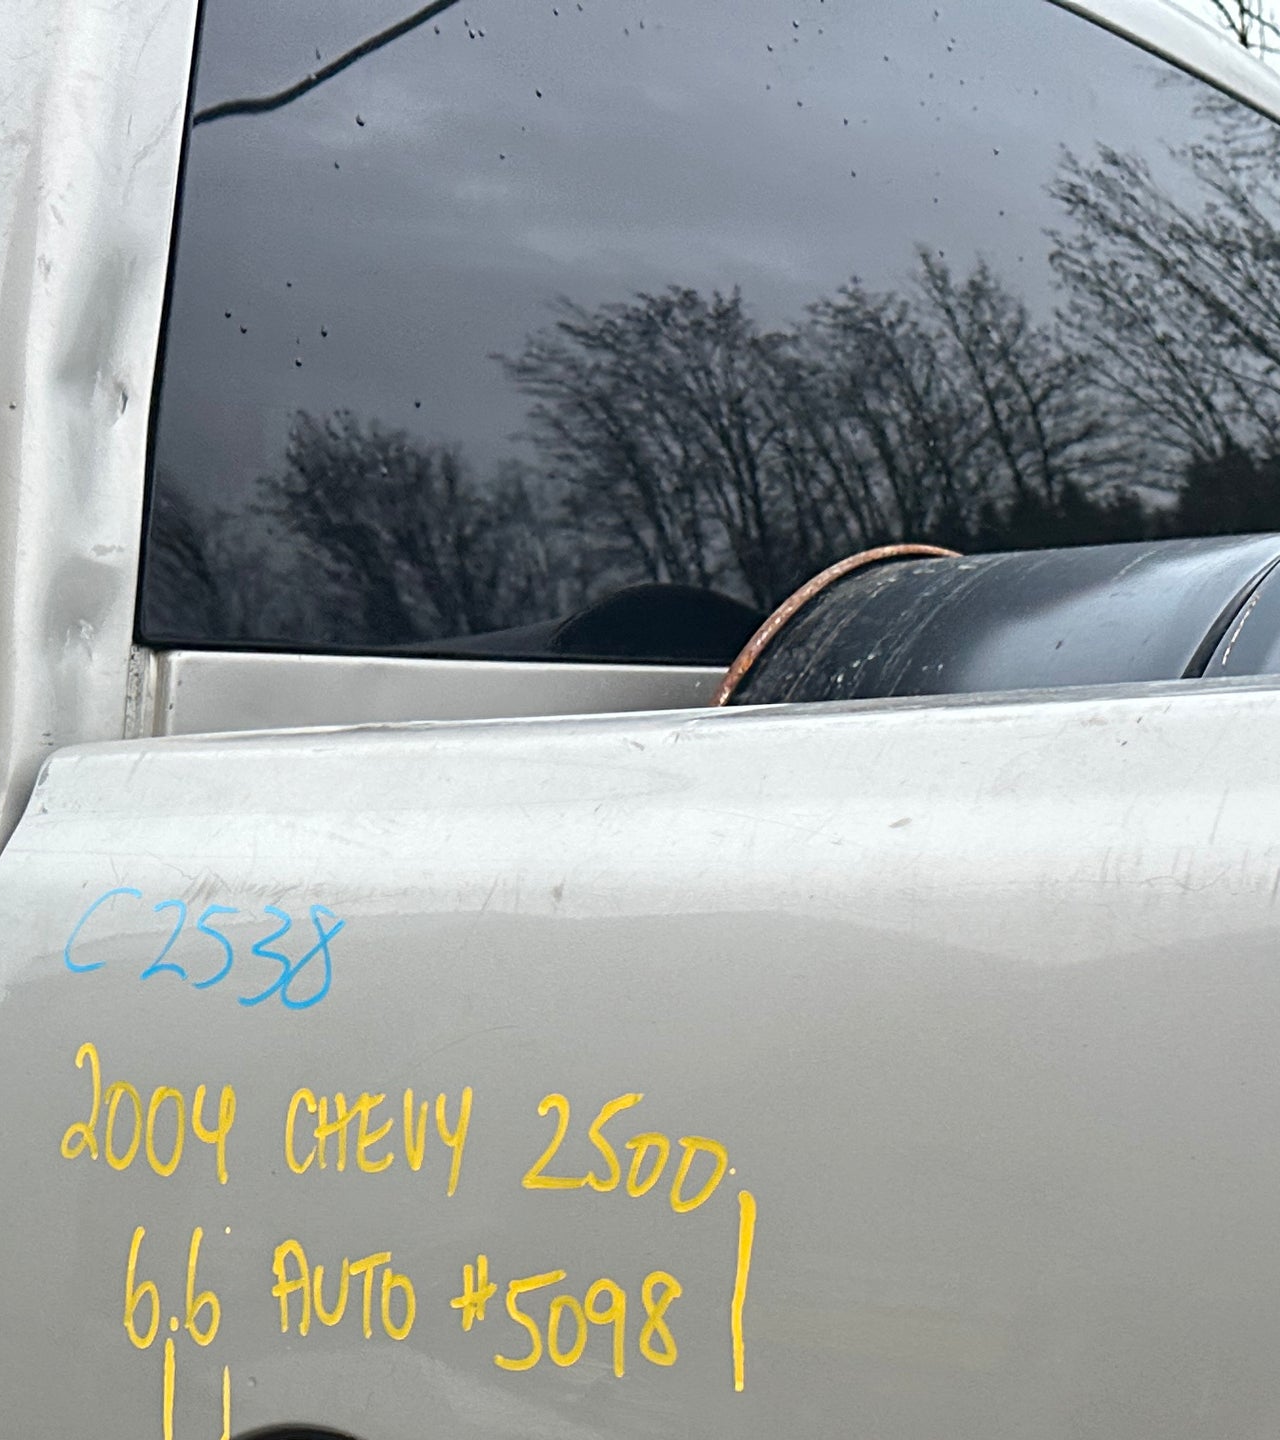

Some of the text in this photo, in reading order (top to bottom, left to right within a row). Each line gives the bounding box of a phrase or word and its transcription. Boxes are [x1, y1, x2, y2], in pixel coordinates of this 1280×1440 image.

[60, 1042, 730, 1213] 2004 CHEVY 2500
[124, 1226, 682, 1378] 6.6 AUTO #5098
